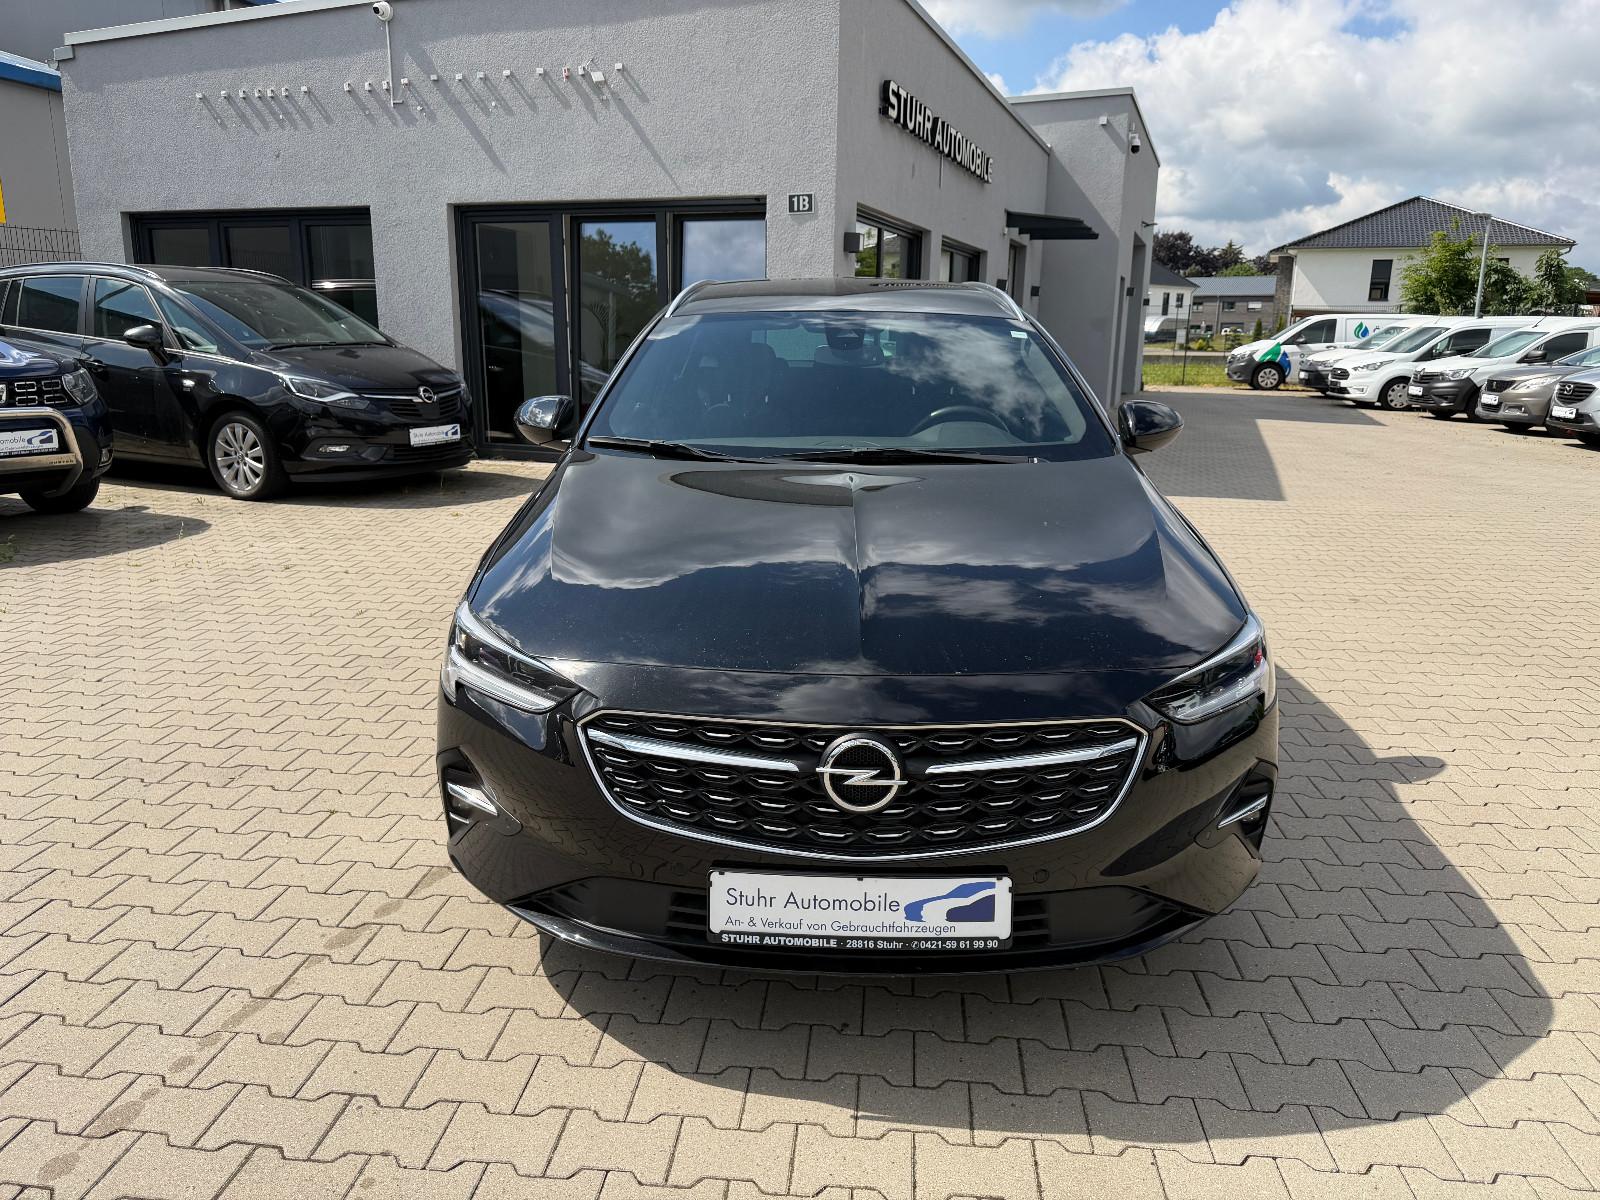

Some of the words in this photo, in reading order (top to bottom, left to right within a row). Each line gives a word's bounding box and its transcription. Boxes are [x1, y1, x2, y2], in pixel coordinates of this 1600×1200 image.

[888, 80, 933, 144] STUHR
[934, 117, 994, 183] AUTOMOBILE
[792, 195, 809, 211] 1B
[726, 887, 776, 907] Stuhr
[783, 891, 900, 912] Automobile
[724, 915, 744, 926] An-
[747, 916, 757, 927] &
[760, 917, 804, 930] Verkauf
[830, 920, 956, 936] Gebrauchtfahrzeugen
[721, 933, 760, 944] STUHR
[762, 936, 838, 947] AUTOMOBILE
[846, 939, 874, 949] 28816
[877, 940, 903, 949] Stuhr
[920, 940, 957, 949] 0421-59
[959, 940, 971, 949] 61
[973, 940, 985, 949] 99
[986, 939, 998, 948] 90
